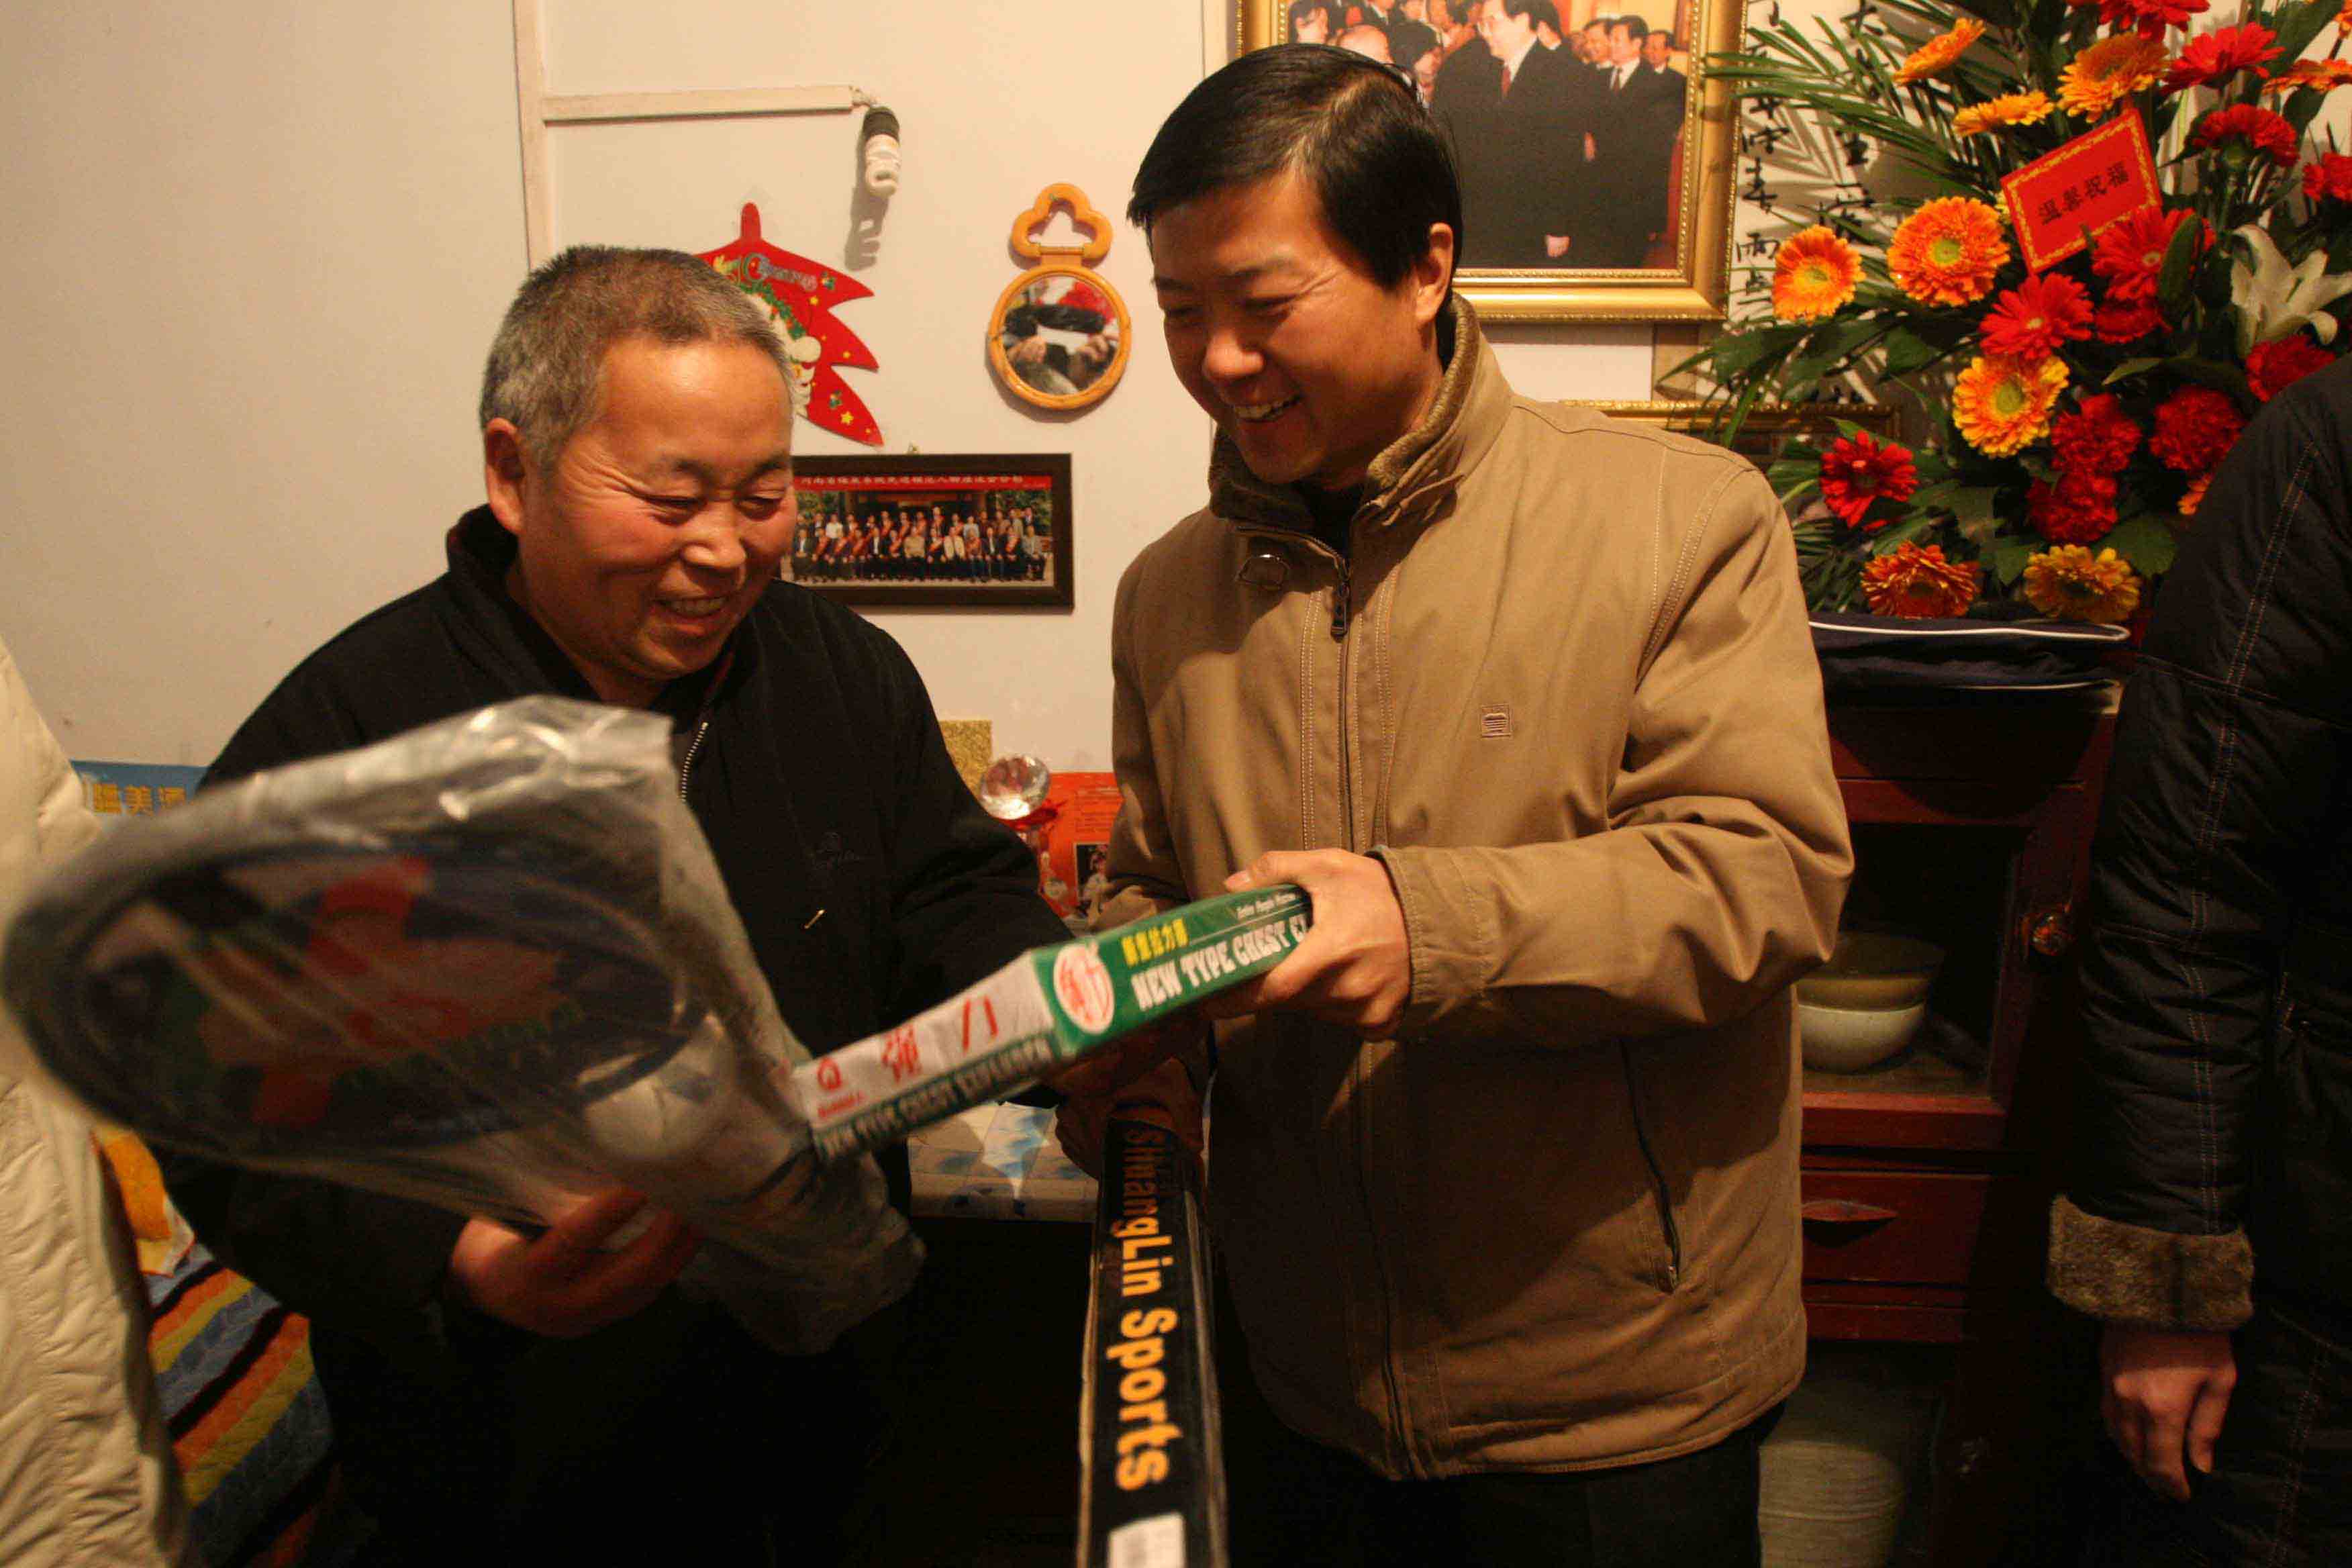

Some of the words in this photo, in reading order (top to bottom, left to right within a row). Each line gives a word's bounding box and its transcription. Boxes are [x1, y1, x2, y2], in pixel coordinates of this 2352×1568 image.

[2038, 161, 2129, 226] 温馨祝福
[1130, 960, 1183, 1012] NEW
[1179, 941, 1236, 988] TYPE
[1232, 920, 1291, 967] CHEST
[1106, 1308, 1183, 1492] Sports
